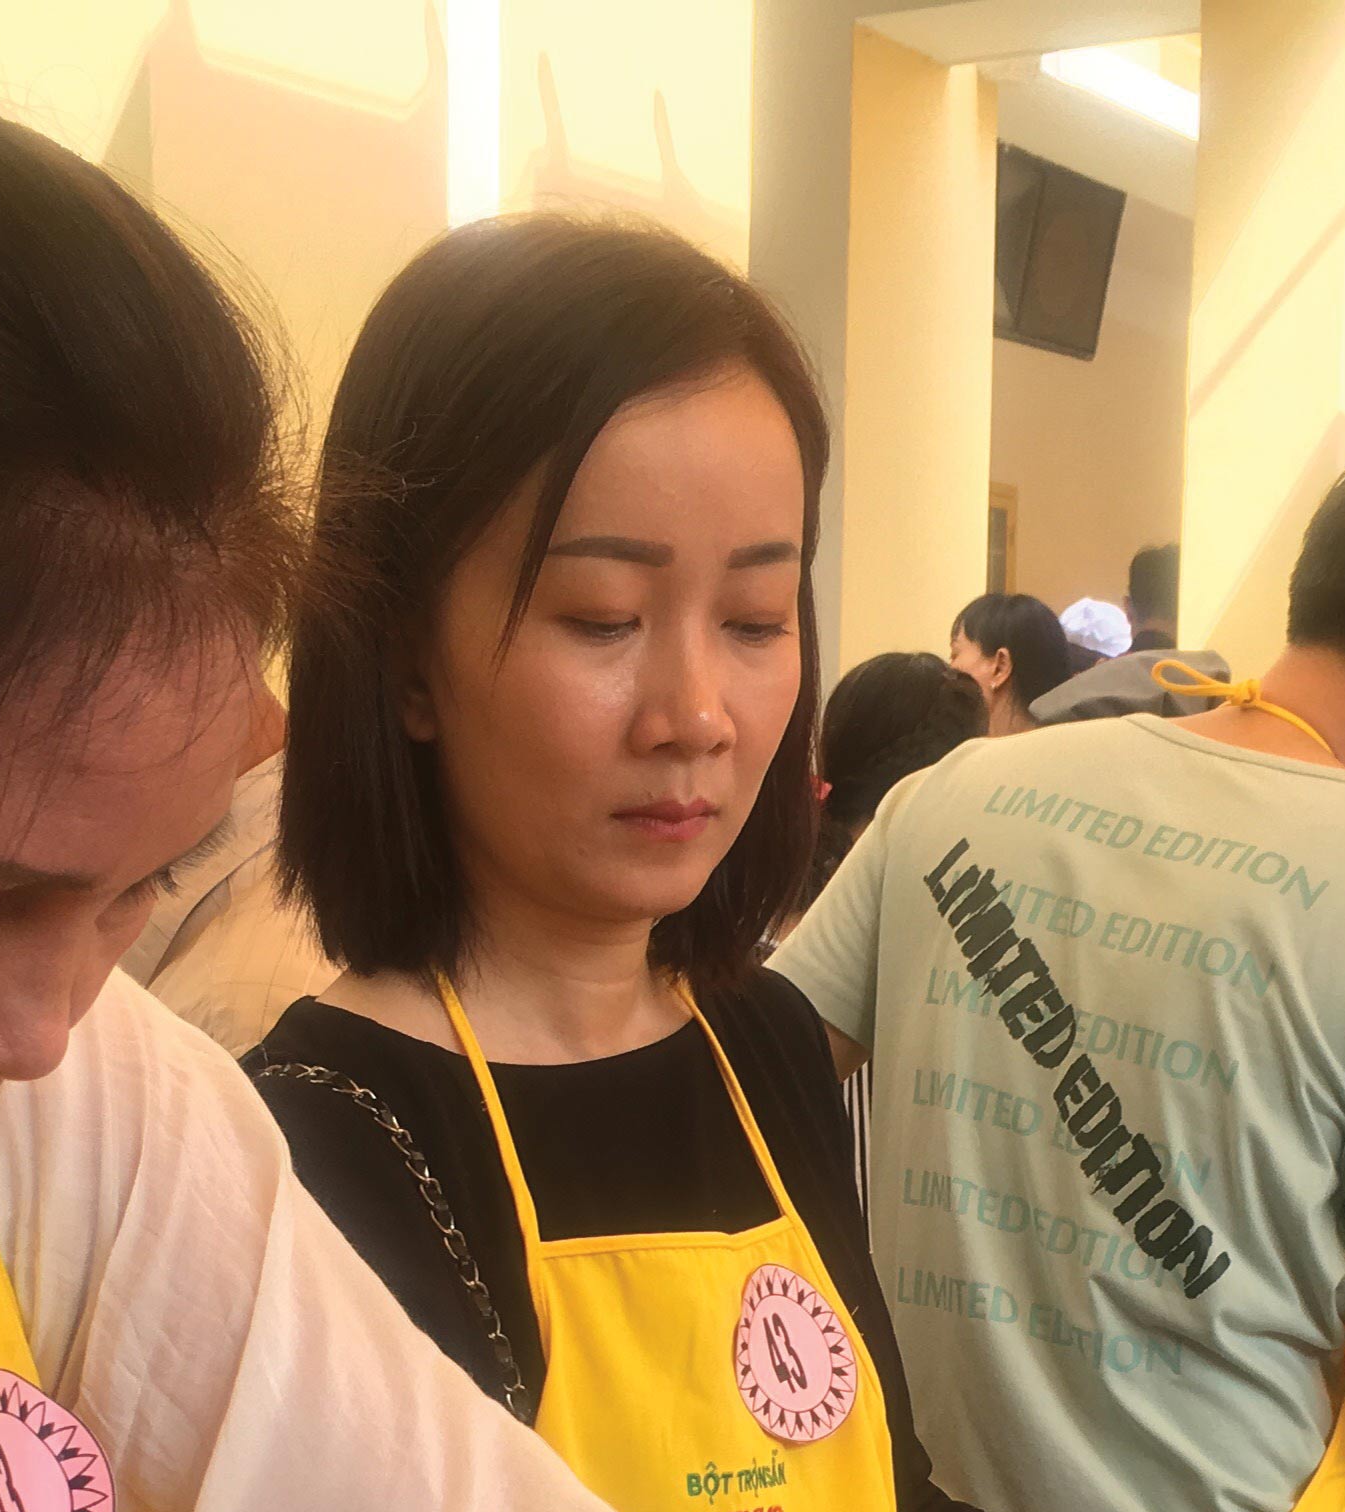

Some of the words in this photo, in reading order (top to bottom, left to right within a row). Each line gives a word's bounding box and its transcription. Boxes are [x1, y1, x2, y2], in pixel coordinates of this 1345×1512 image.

[982, 784, 1144, 850] LIMITED
[1142, 823, 1331, 912] EDITION
[1099, 912, 1278, 999] EDITION
[922, 837, 1077, 1070] LIMITED
[1053, 1053, 1233, 1300] EDITION
[896, 1266, 1019, 1325] LIMITED
[762, 1312, 808, 1394] 43
[686, 1461, 734, 1505] BỘT
